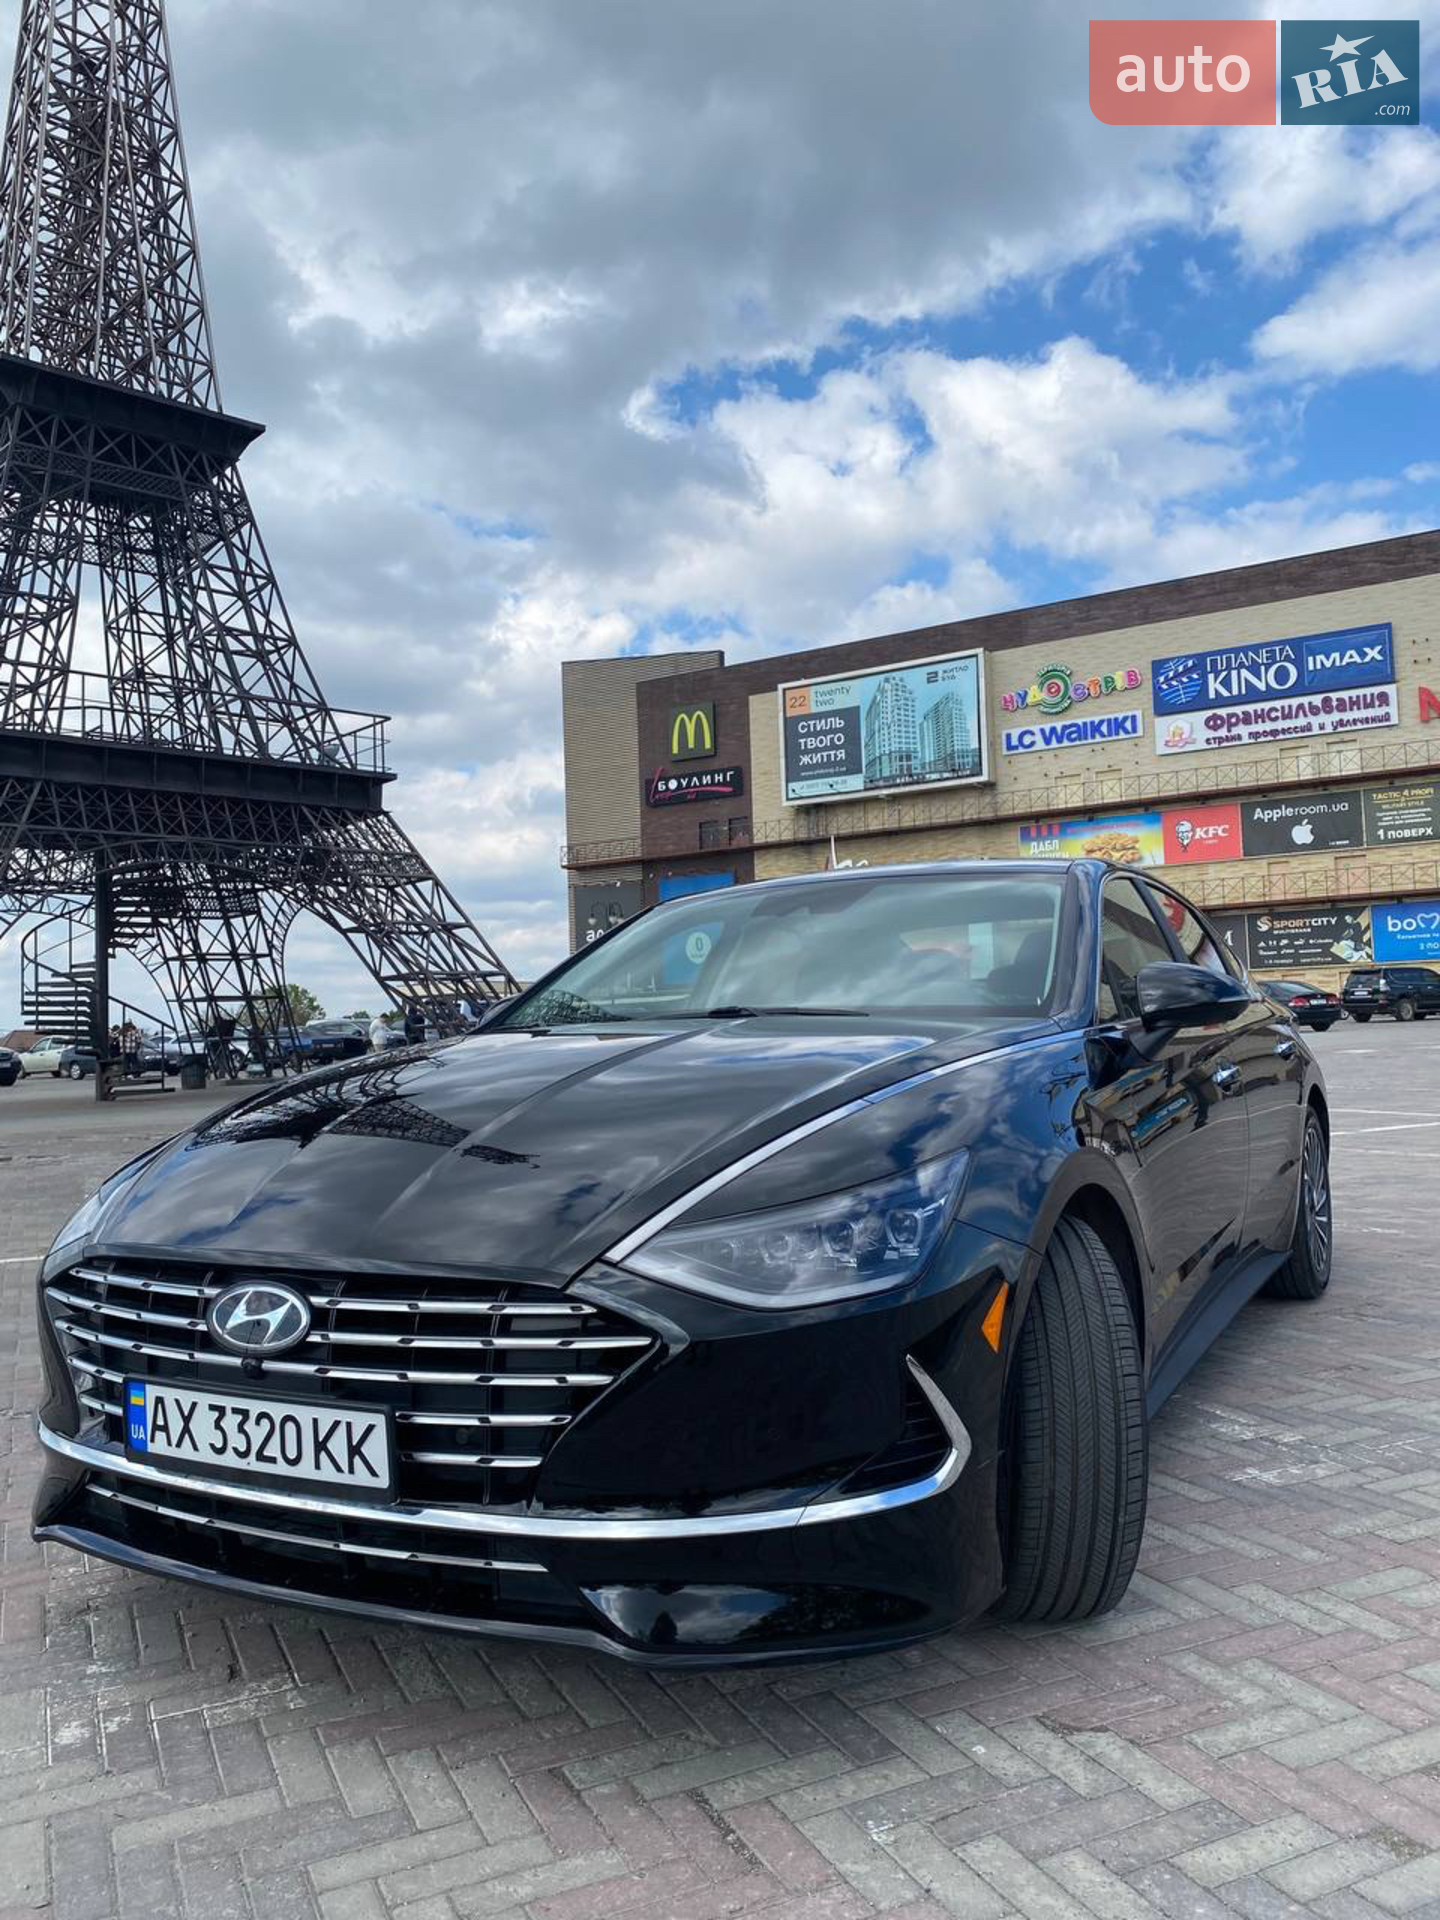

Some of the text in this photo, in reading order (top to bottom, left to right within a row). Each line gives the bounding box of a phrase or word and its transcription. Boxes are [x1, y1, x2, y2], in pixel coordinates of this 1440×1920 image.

[1308, 645, 1384, 671] IMAX
[1208, 661, 1298, 699] KINO
[814, 685, 851, 698] twenty
[789, 695, 807, 709] 22
[815, 697, 835, 707] two
[798, 716, 846, 733] СТИЛЬ
[799, 733, 845, 750] ТВОГО
[1005, 729, 1036, 752] LC
[799, 749, 846, 766] ЖИТТЯ
[657, 771, 735, 791] БОУЛИНГ
[1254, 802, 1349, 823] Appleroom.ua
[1195, 824, 1229, 839] KFC
[1377, 827, 1434, 840] 1 ПОВЕРХ
[1273, 917, 1337, 928] SPORTCITY
[131, 1424, 146, 1441] UA
[150, 1396, 379, 1478] AX 3320 KK
